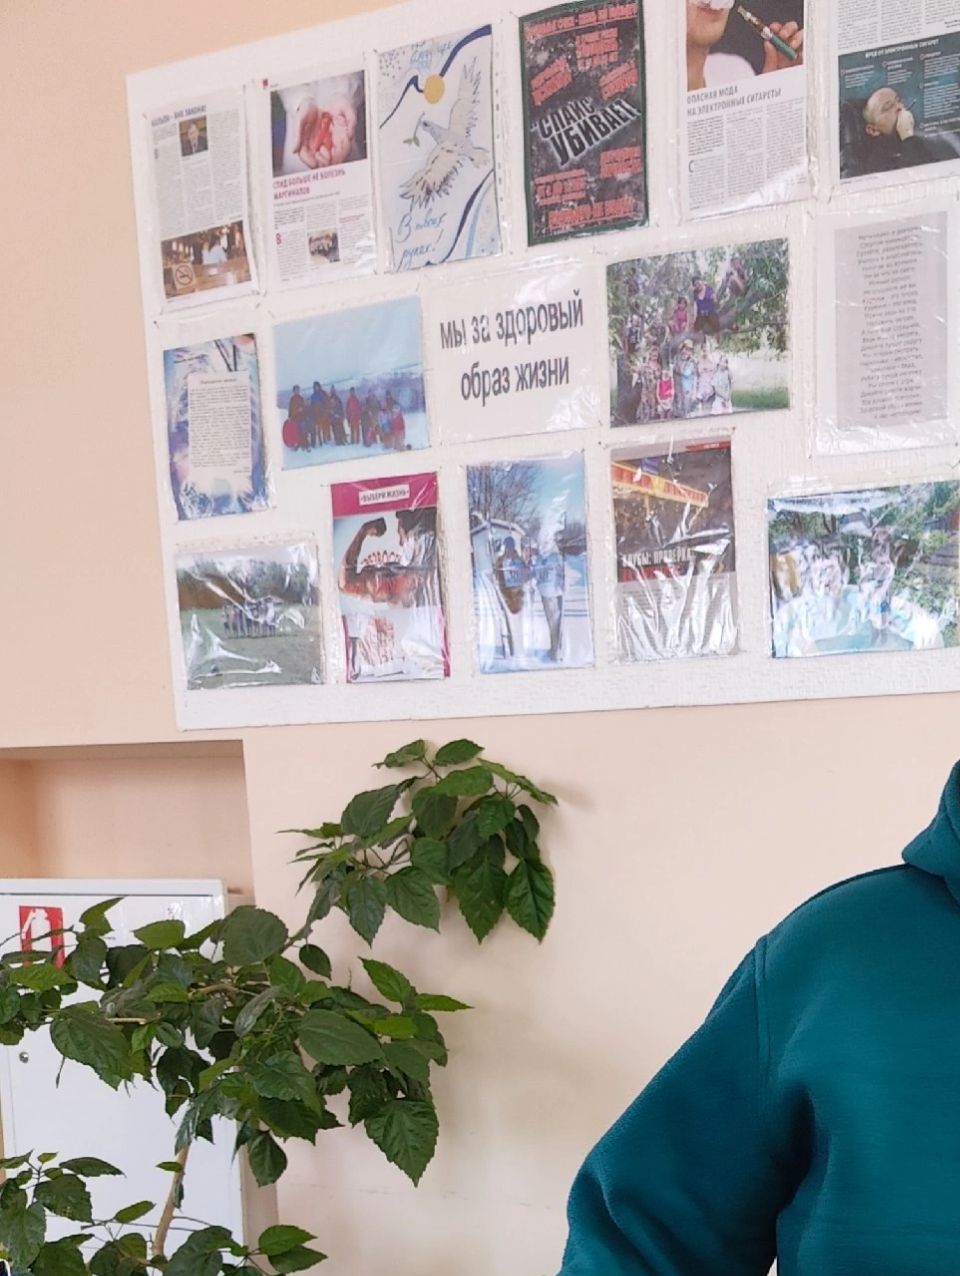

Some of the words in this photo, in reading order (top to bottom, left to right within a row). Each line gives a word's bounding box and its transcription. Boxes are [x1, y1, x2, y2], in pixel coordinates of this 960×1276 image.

[440, 319, 467, 349] мы
[471, 314, 491, 344] за
[495, 288, 583, 347] здоровый
[461, 361, 511, 407] образ
[515, 356, 570, 392] жизни
